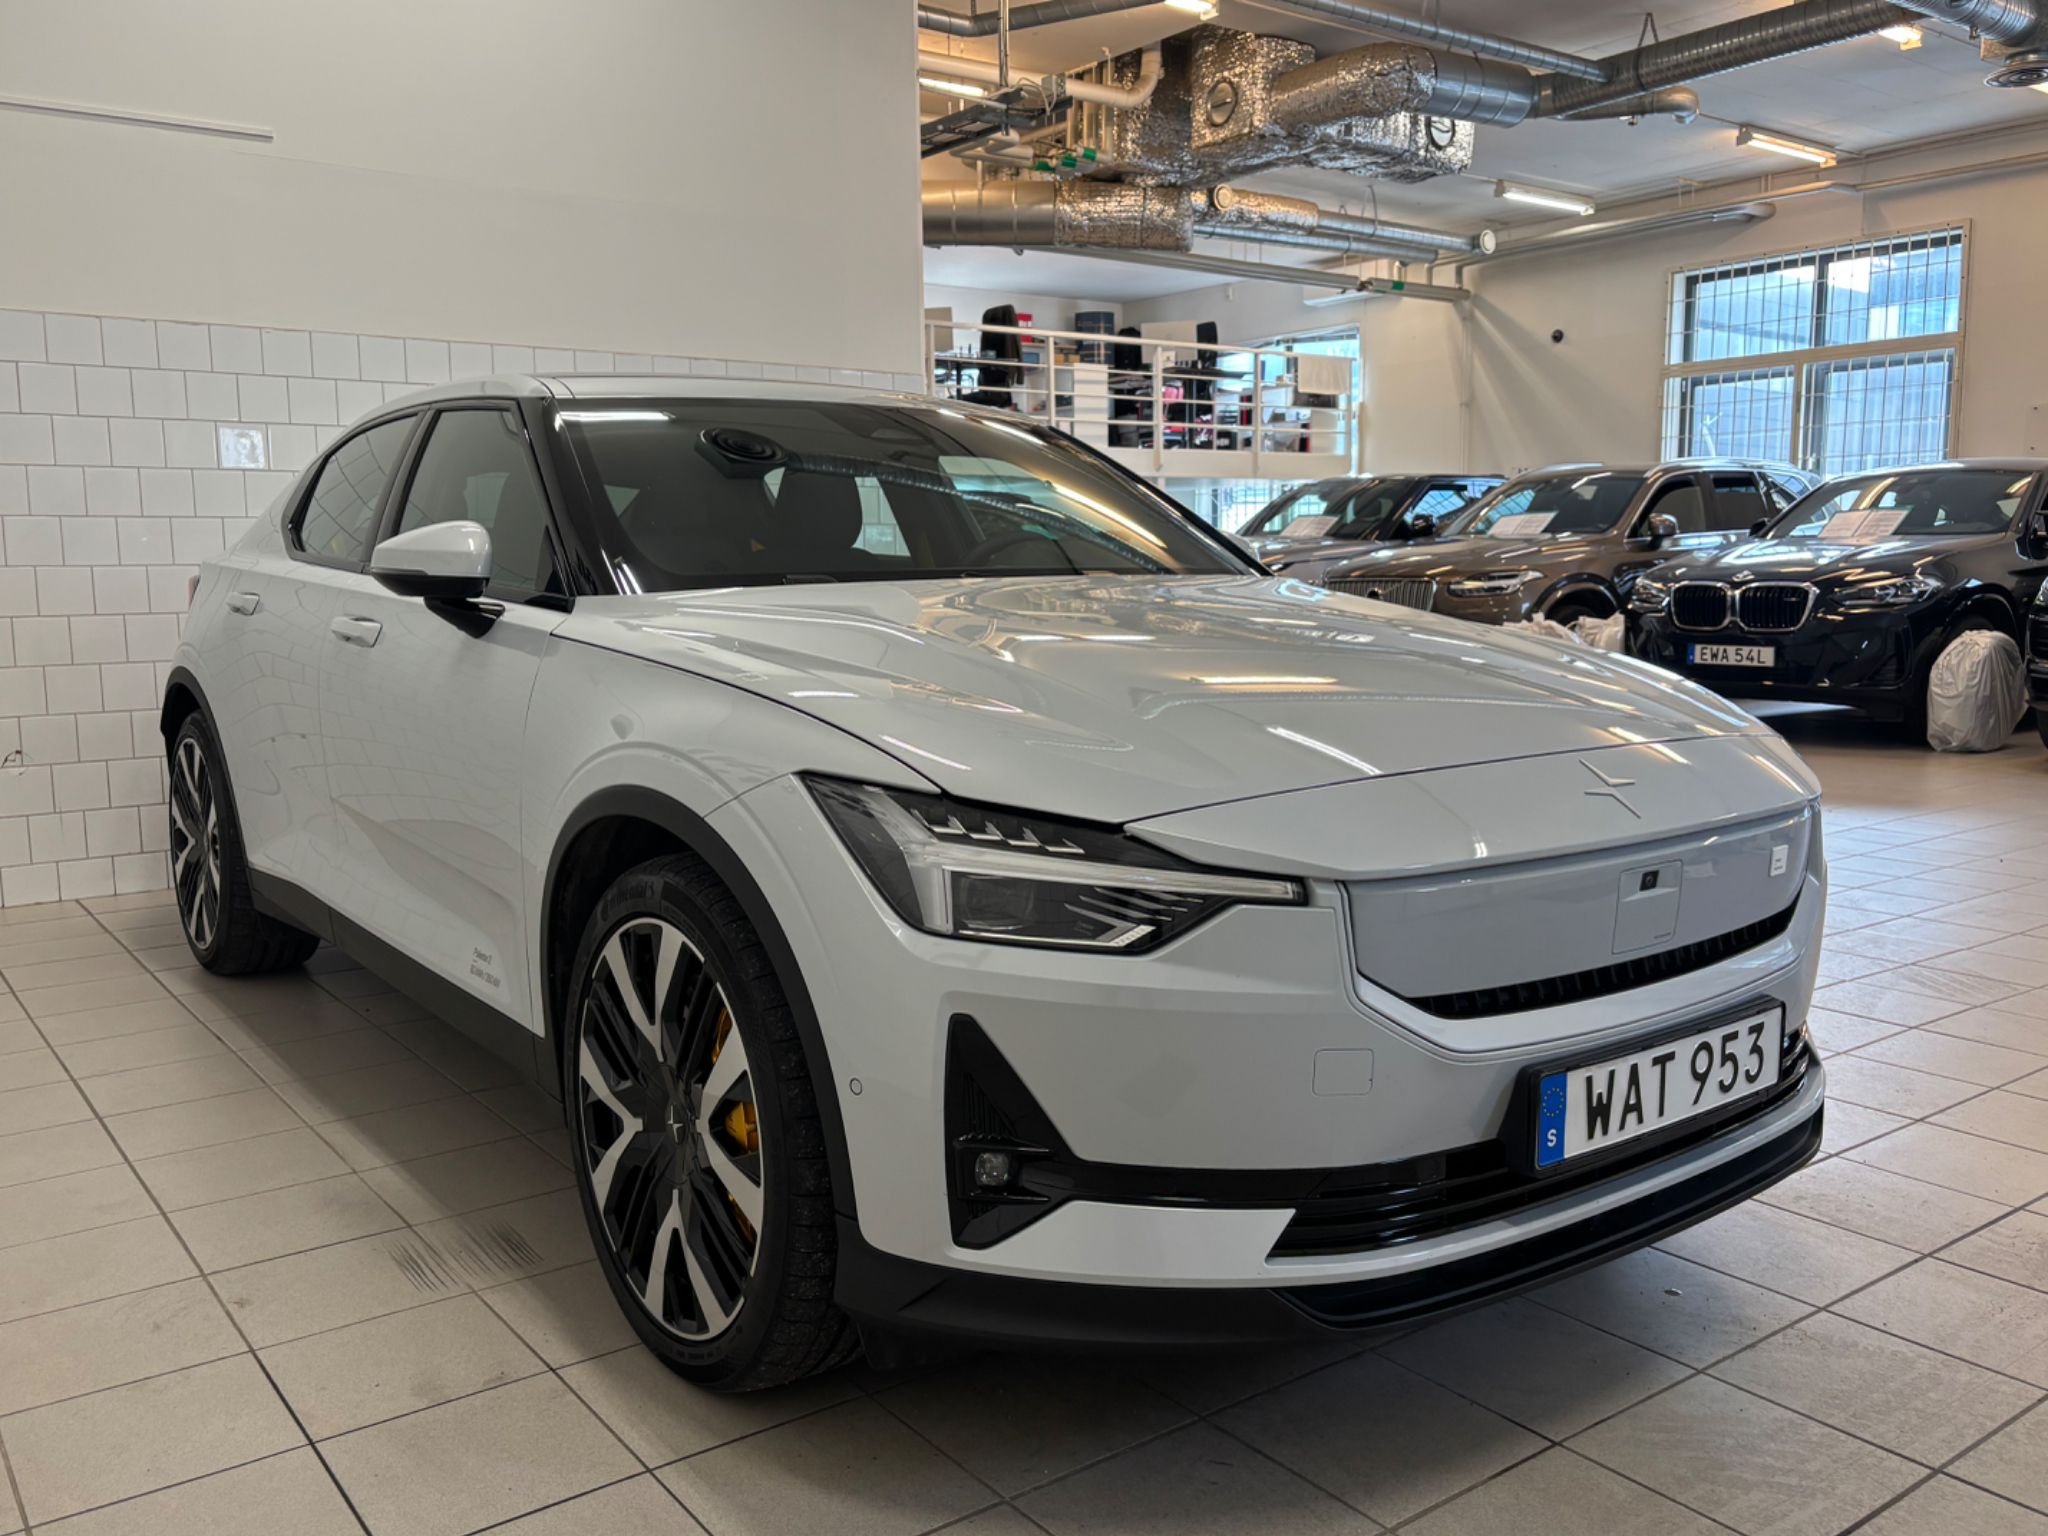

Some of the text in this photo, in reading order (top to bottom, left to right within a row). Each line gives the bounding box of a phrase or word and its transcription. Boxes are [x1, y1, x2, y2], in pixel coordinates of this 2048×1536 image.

[1700, 646, 1766, 664] EWA 54L
[1585, 1022, 1765, 1140] WAT 953
[1546, 1129, 1557, 1147] S
